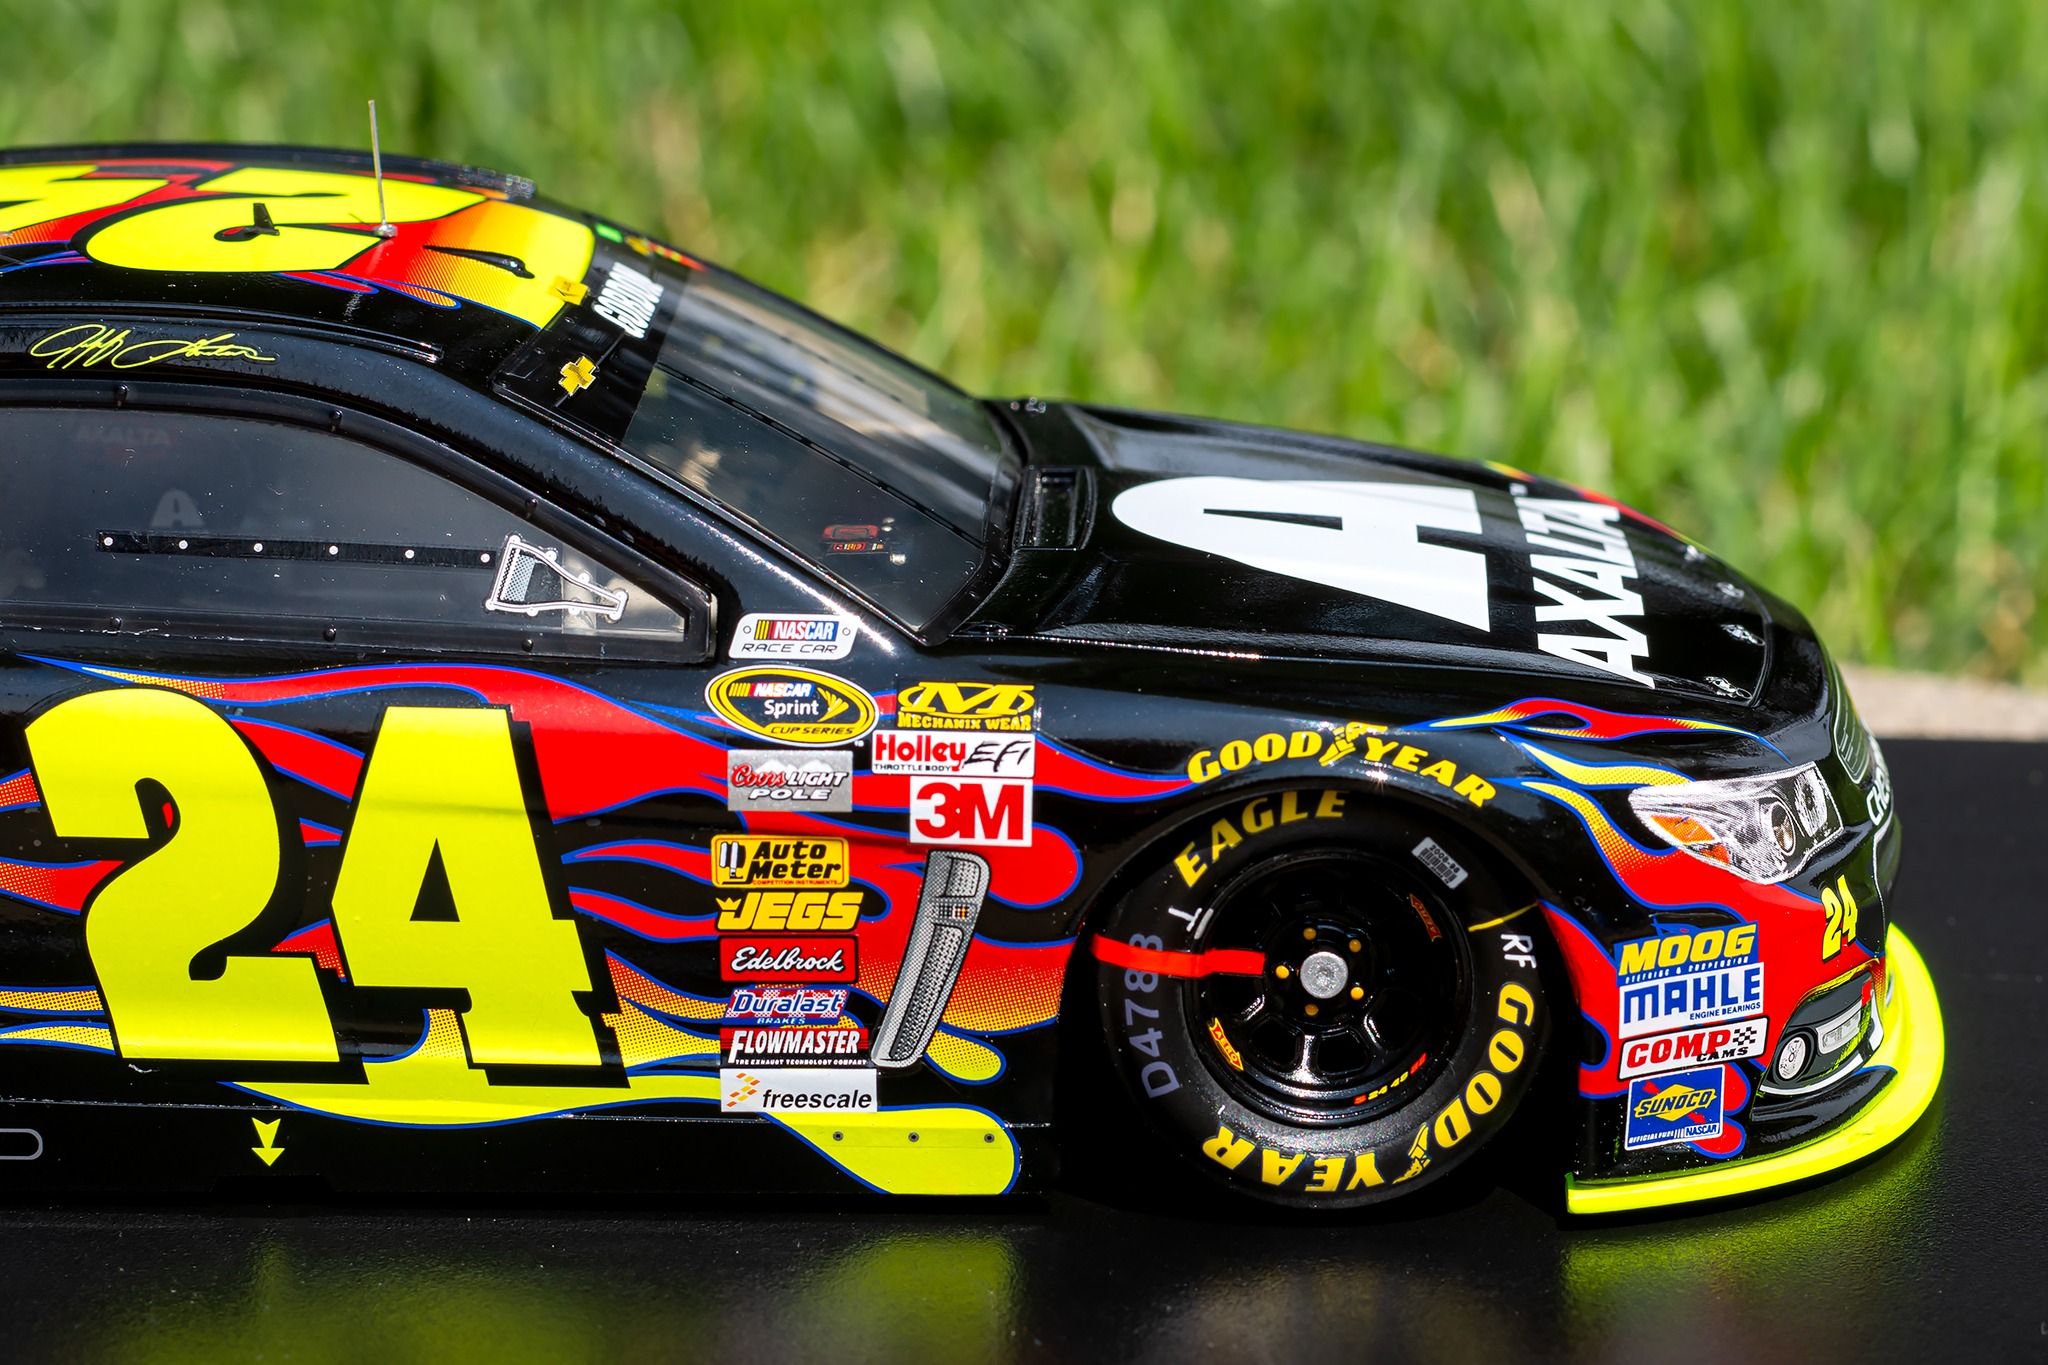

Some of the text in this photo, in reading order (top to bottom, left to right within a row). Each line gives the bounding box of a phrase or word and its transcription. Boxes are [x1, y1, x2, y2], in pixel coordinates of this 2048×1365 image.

[1514, 496, 1655, 689] AXALTA
[774, 621, 835, 640] NASCAR
[741, 643, 838, 653] RACE CAR
[753, 683, 812, 697] NASCAR
[764, 700, 819, 719] Sprint
[771, 727, 855, 735] CUP SERIES
[897, 712, 1032, 731] MECHANIX WEAR
[875, 734, 1032, 772] Holley EFI
[731, 763, 850, 787] Coors LIGHT
[874, 763, 951, 772] THROTTLE BODY
[748, 788, 833, 801] POLE
[915, 781, 1025, 841] 3M
[1173, 789, 1348, 888] EAGLE
[752, 841, 827, 860] Auto
[24, 687, 603, 1065] 24
[746, 860, 842, 880] Meter
[717, 891, 865, 931] JEGS
[1821, 874, 1859, 961] 24
[730, 946, 845, 973] Edelbrock
[1500, 933, 1538, 970] RF
[1618, 923, 1757, 977] MOOG
[732, 992, 843, 1014] Duralast
[1623, 966, 1761, 1025] MAHLE
[756, 1017, 806, 1025] BRAKES
[1689, 1001, 1761, 1021] ENGINE BEARINGS
[727, 1030, 861, 1064] FLOWMASTER
[1626, 1029, 1732, 1069] COMP
[1696, 1046, 1749, 1063] CAMS
[762, 1088, 872, 1109] freescale
[1637, 1089, 1714, 1117] SUNOCO
[1628, 1131, 1658, 1145] OFFICIAL
[1685, 1123, 1719, 1138] NASCAR
